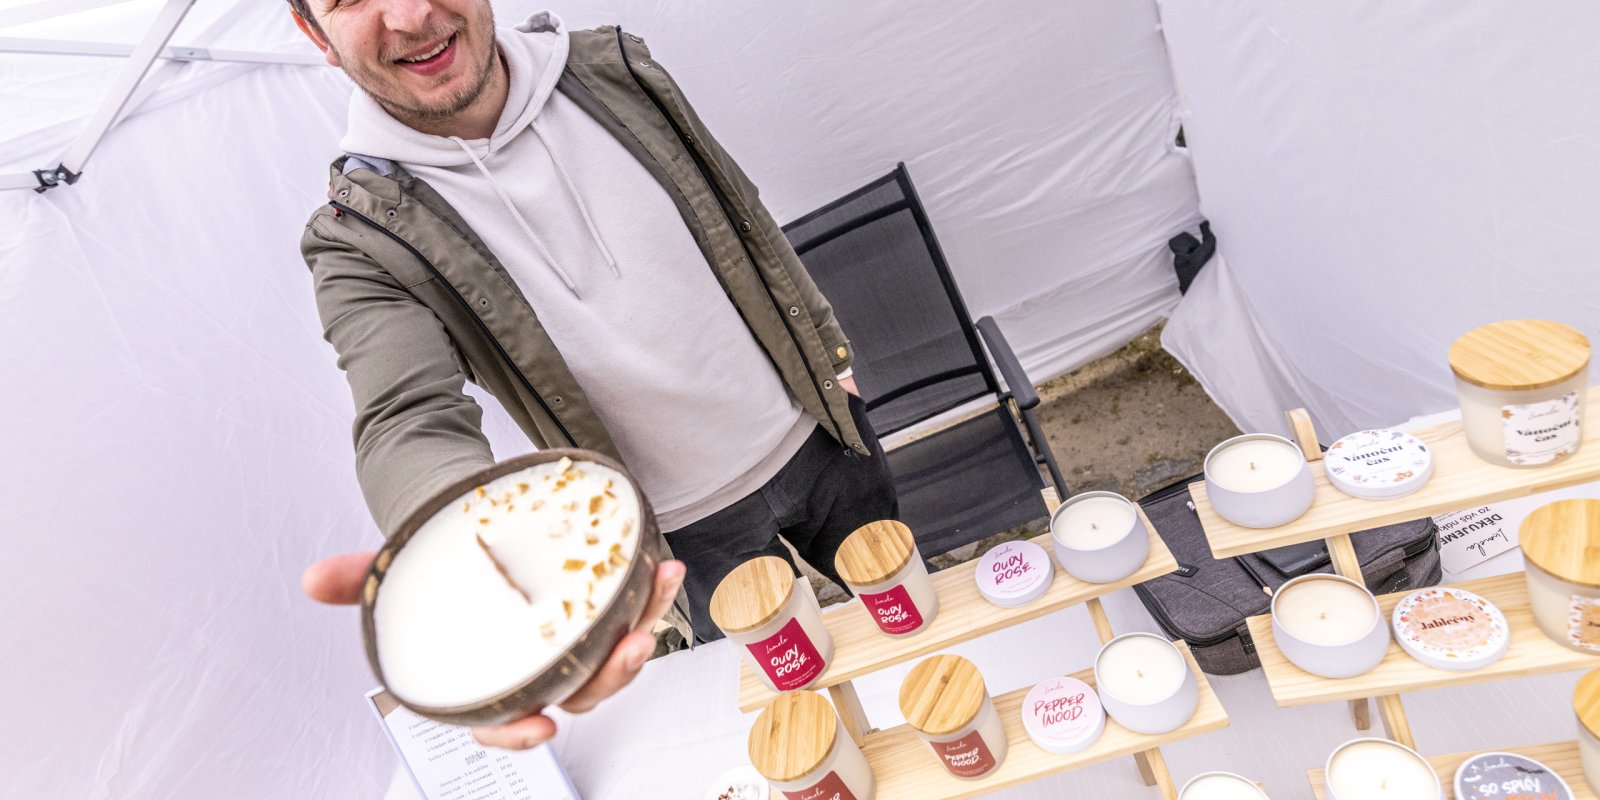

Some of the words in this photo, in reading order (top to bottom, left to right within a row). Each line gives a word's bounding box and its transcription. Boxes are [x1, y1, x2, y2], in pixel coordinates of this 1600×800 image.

[1343, 443, 1404, 462] Vánoční
[1366, 457, 1391, 466] čas
[1478, 506, 1491, 514] za
[995, 561, 1036, 585] ROSE.
[881, 610, 912, 623] ROSE.
[1421, 612, 1475, 631] Jablečný
[775, 652, 811, 677] ROSE.
[1034, 693, 1085, 717] PEPPER
[1479, 782, 1499, 797] SO
